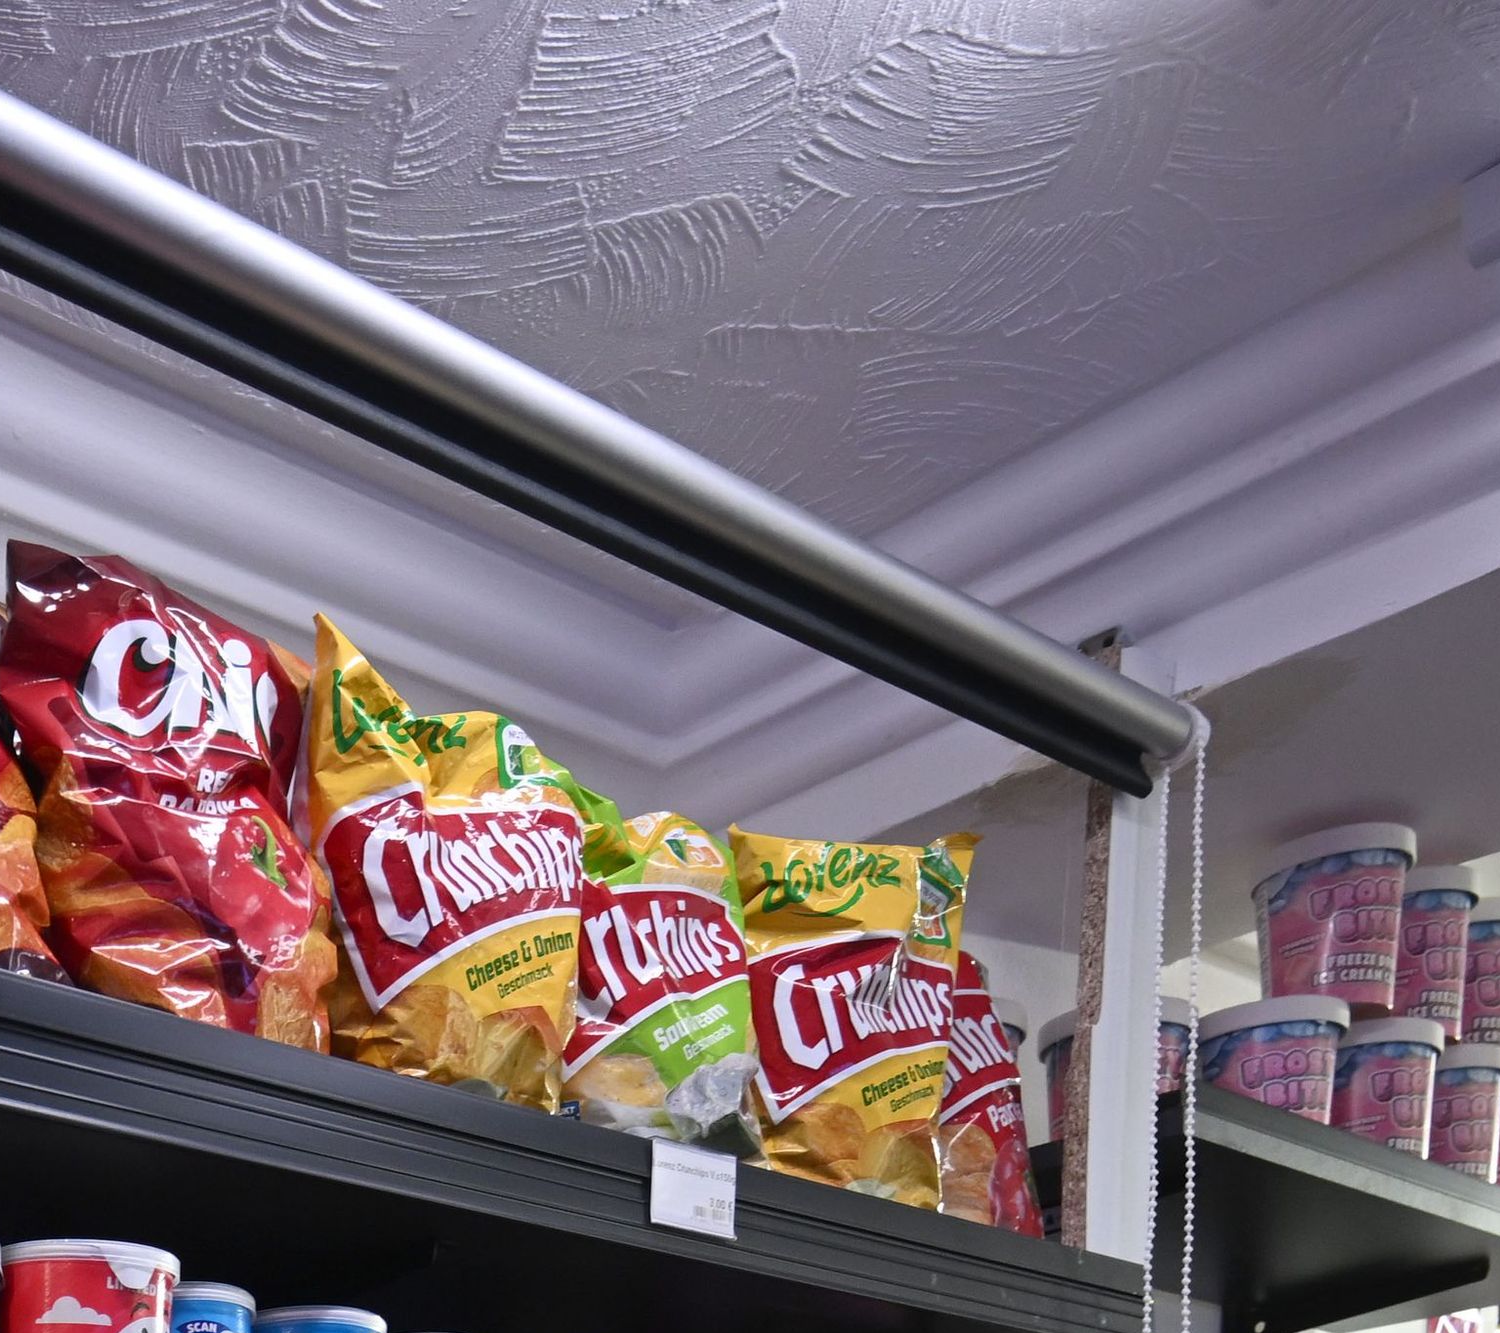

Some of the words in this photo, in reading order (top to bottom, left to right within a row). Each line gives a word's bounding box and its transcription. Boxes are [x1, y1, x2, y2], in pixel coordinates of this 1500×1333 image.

[761, 841, 903, 914] Lorenz
[465, 951, 520, 992] Cheese
[521, 942, 535, 963] &
[535, 930, 575, 959] Onion
[1327, 953, 1377, 969] FREEZE
[1339, 968, 1383, 983] CREAM
[497, 962, 553, 999] Geschmack
[861, 1074, 910, 1106] Cheese
[186, 1322, 218, 1333] SCAN
